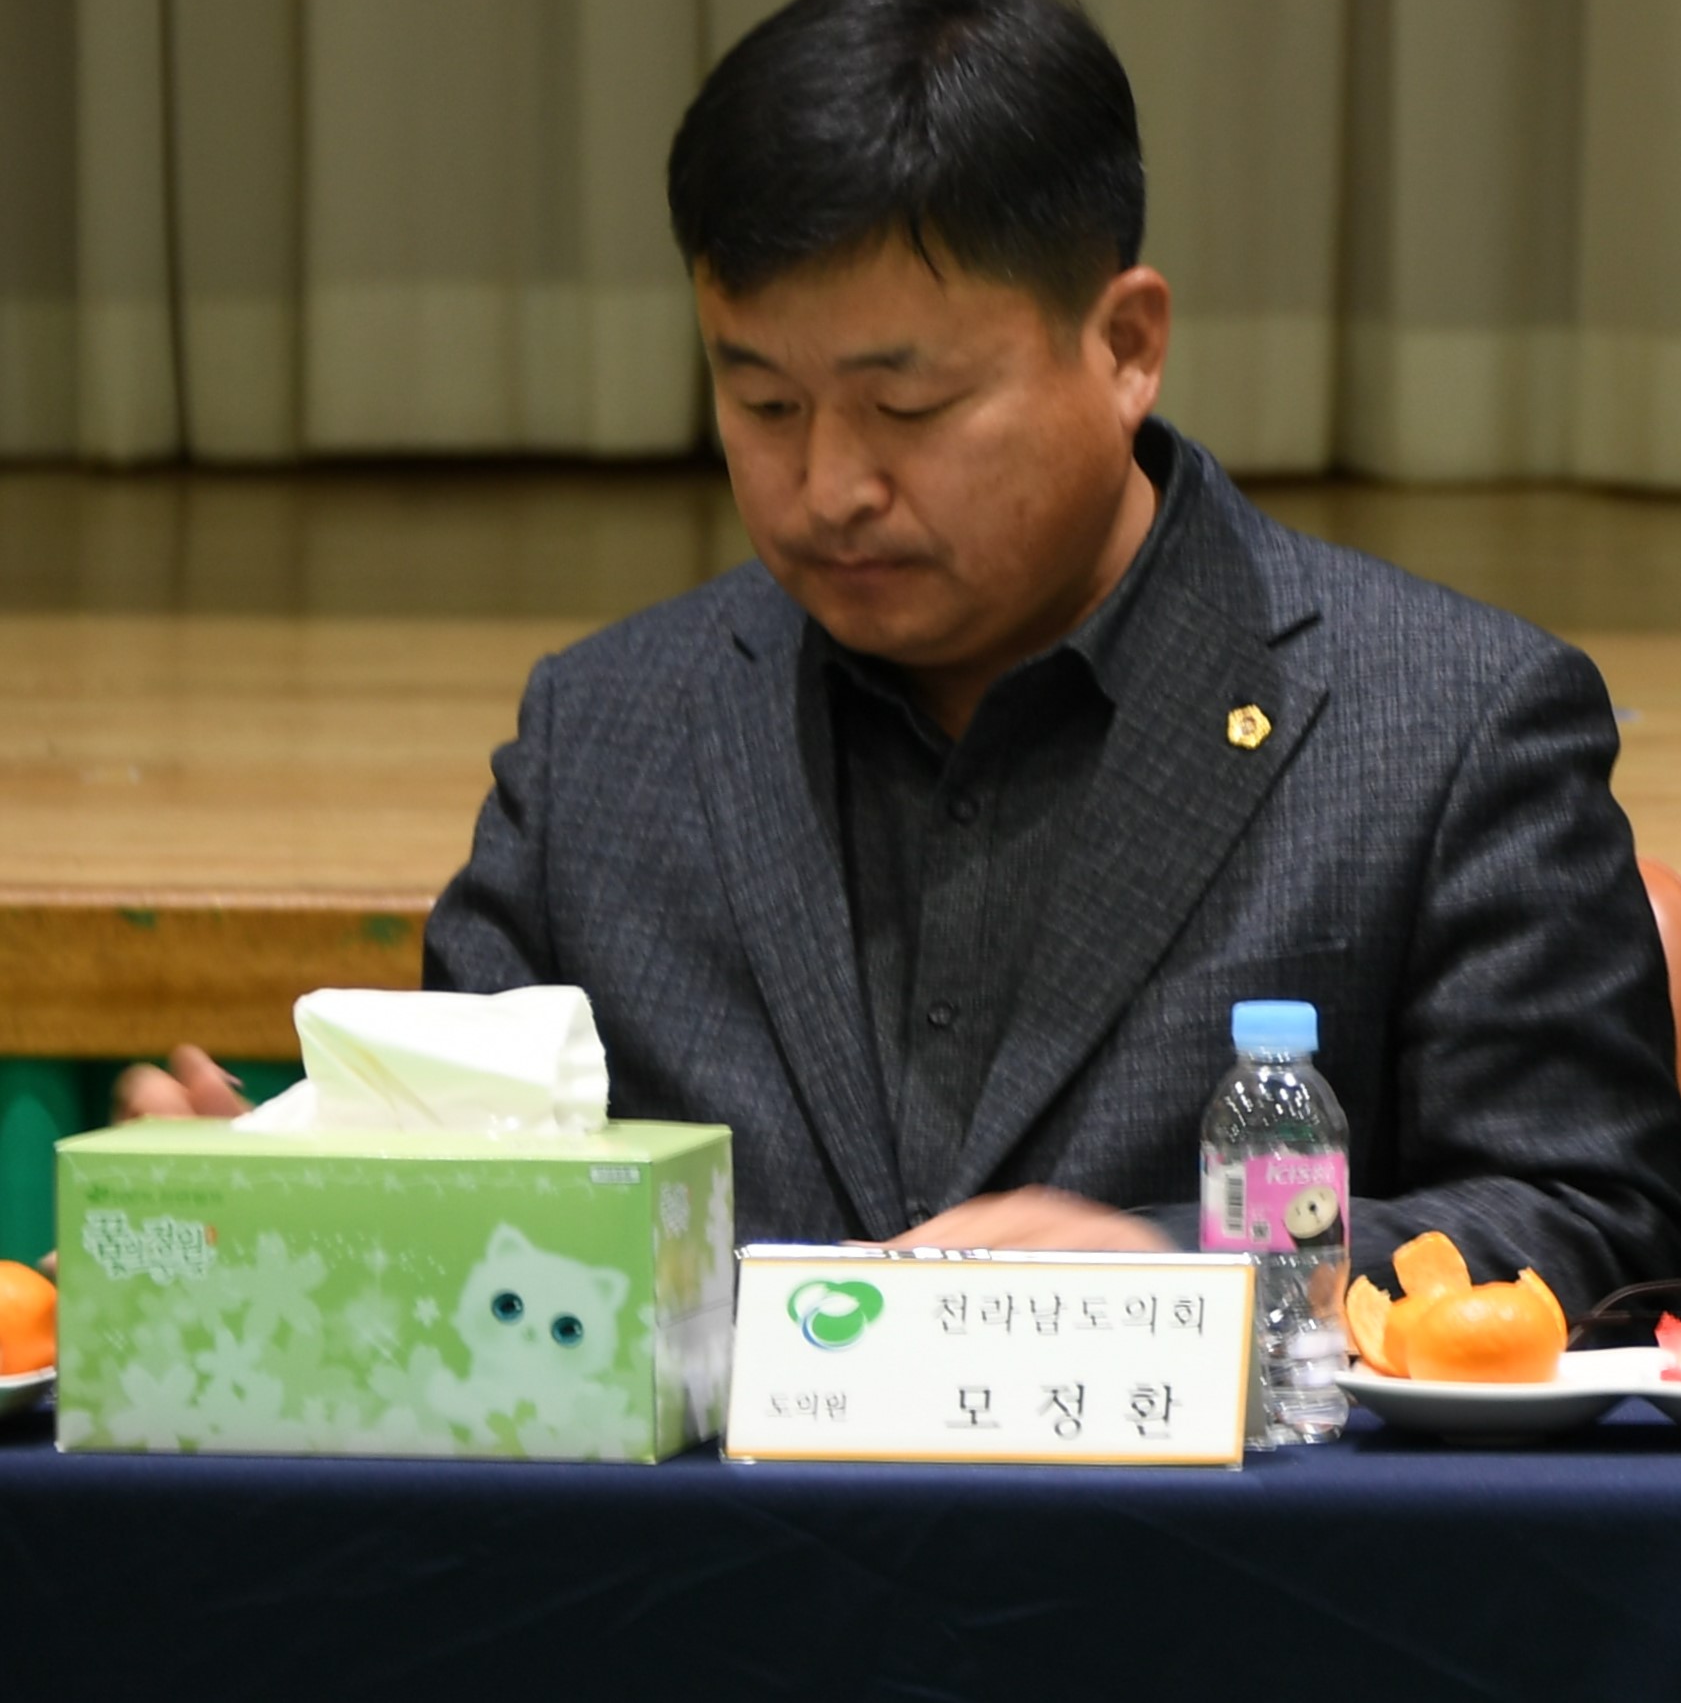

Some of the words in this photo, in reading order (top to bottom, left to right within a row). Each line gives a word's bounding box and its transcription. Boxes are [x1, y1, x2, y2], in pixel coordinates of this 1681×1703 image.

[937, 1292, 1205, 1336] 전라남도의회
[769, 1393, 848, 1420] 도의원
[946, 1382, 1180, 1439] 모정환
